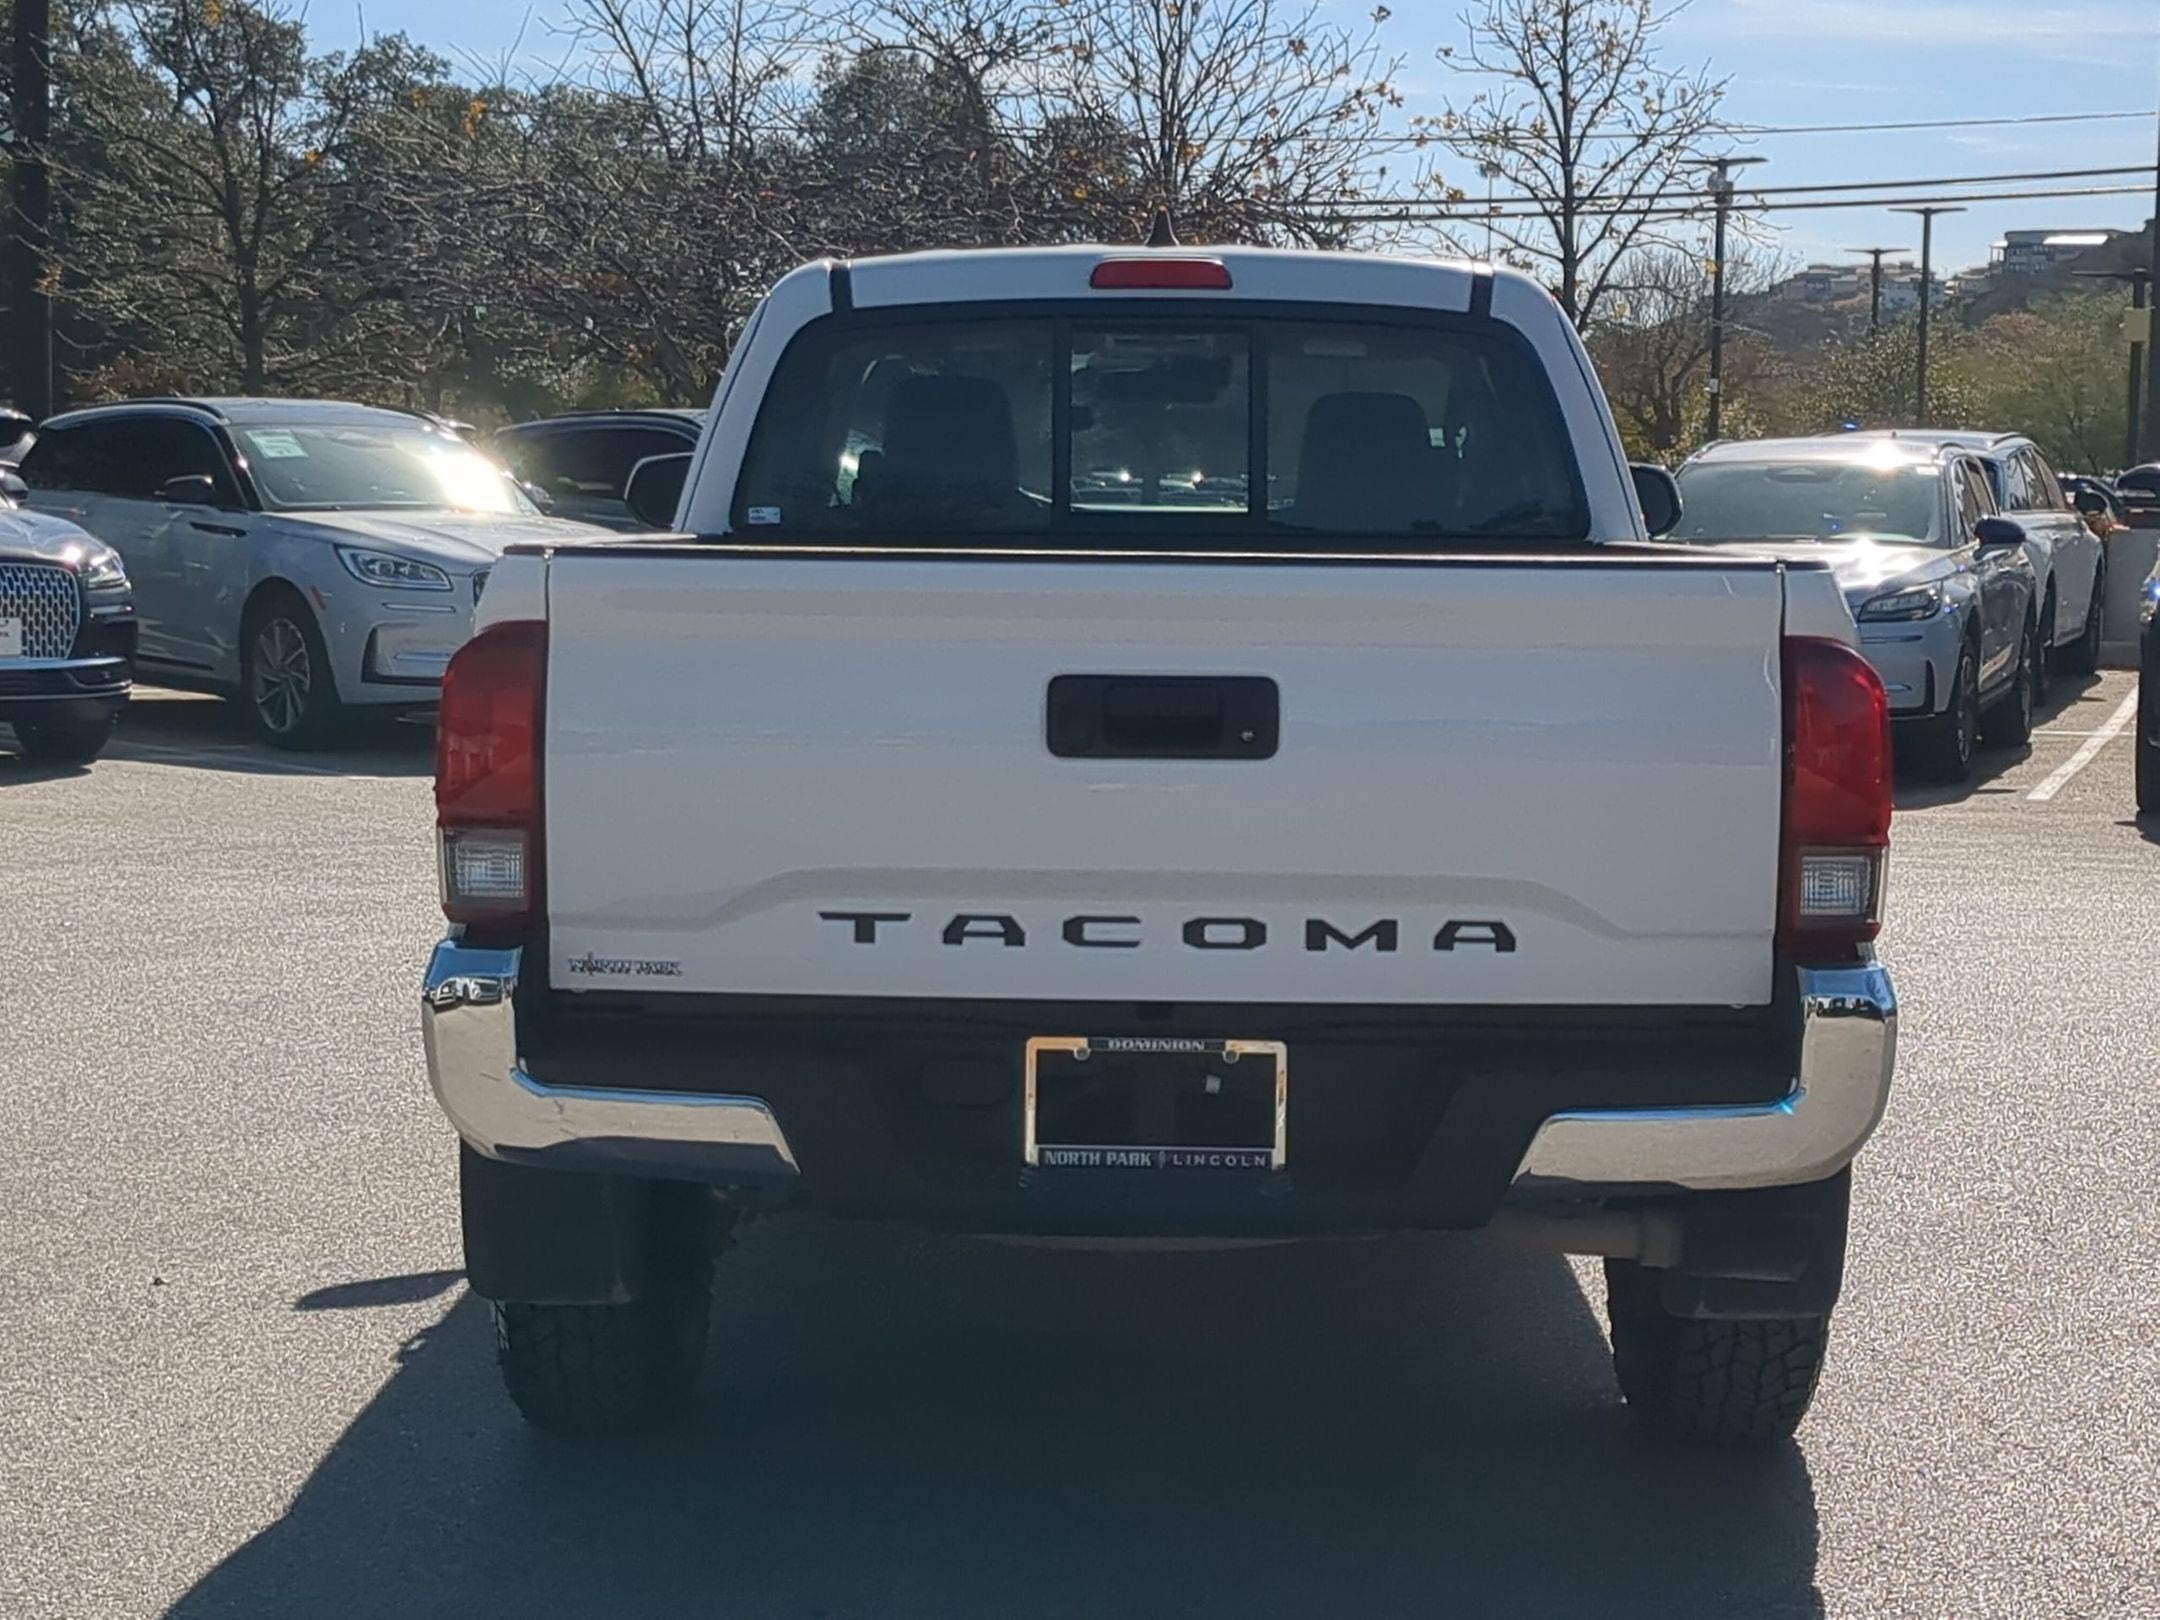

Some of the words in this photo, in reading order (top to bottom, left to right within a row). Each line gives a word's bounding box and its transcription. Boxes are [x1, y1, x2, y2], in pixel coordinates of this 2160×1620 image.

[818, 911, 1516, 953] TACOMA
[1108, 1039, 1205, 1052] DOMINION
[1045, 1151, 1101, 1166] NORTH
[1106, 1151, 1152, 1167] PARK
[1173, 1153, 1266, 1167] LINCOLN
